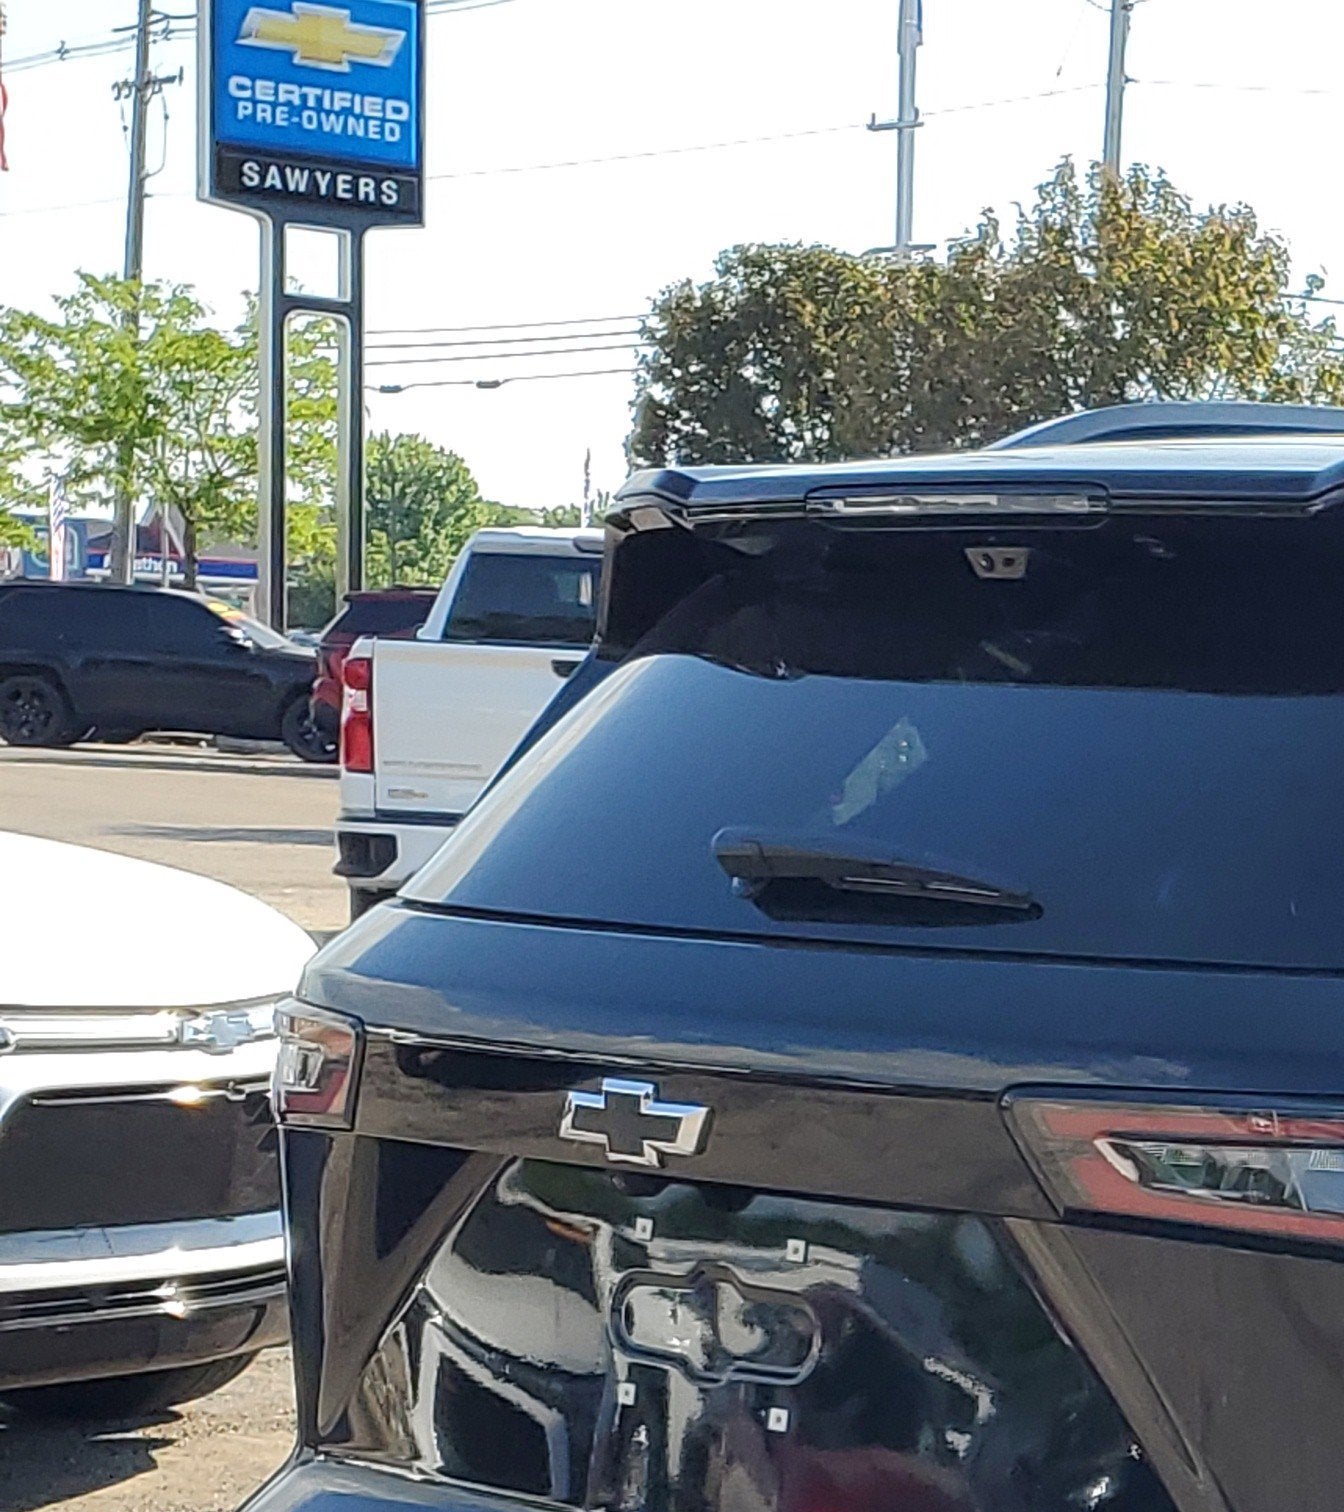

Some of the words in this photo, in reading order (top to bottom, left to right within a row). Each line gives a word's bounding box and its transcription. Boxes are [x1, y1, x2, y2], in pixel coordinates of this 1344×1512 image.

[228, 75, 410, 121] CERTIFIED
[237, 101, 401, 142] PRE-OWNED
[241, 161, 399, 205] SAWYERS
